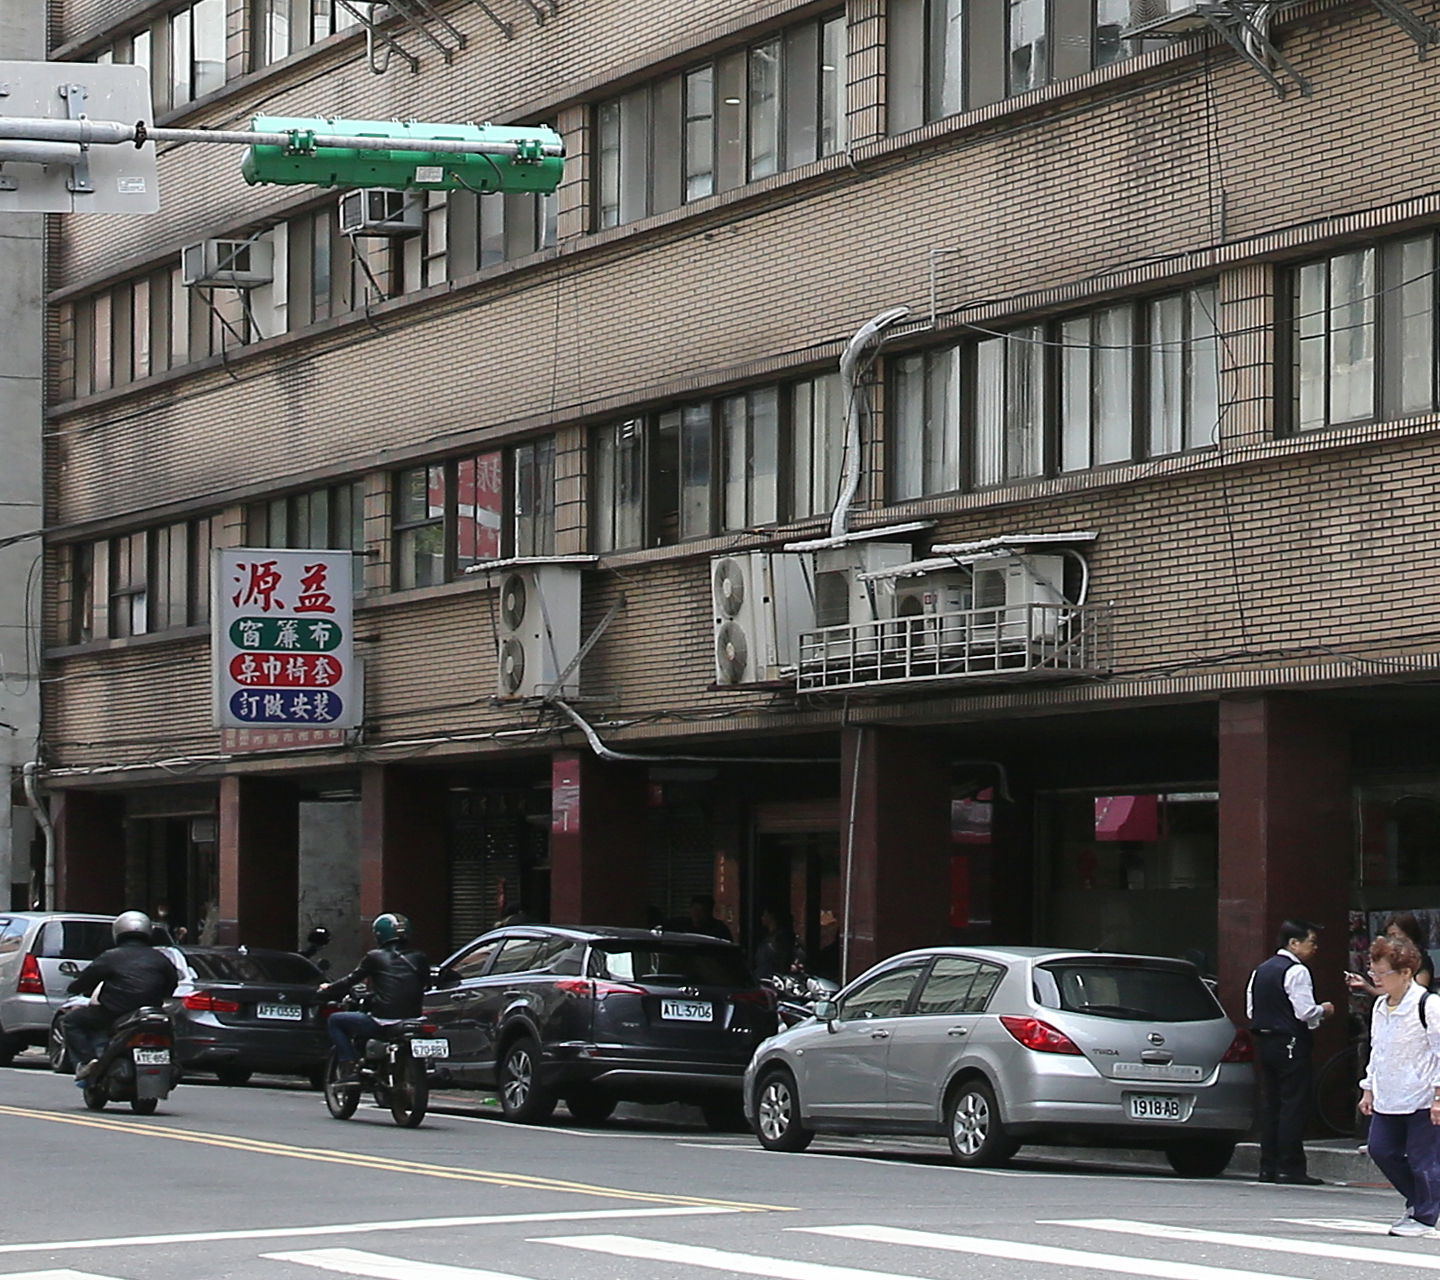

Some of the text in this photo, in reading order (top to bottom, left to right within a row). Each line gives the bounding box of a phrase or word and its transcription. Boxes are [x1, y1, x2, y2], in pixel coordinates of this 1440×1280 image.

[231, 560, 336, 613] 源益
[238, 620, 333, 649] 窗簾布
[236, 655, 336, 685] 桌巾椅套
[239, 691, 334, 722] 訂做安裝
[1132, 1099, 1180, 1117] 1918-AB
